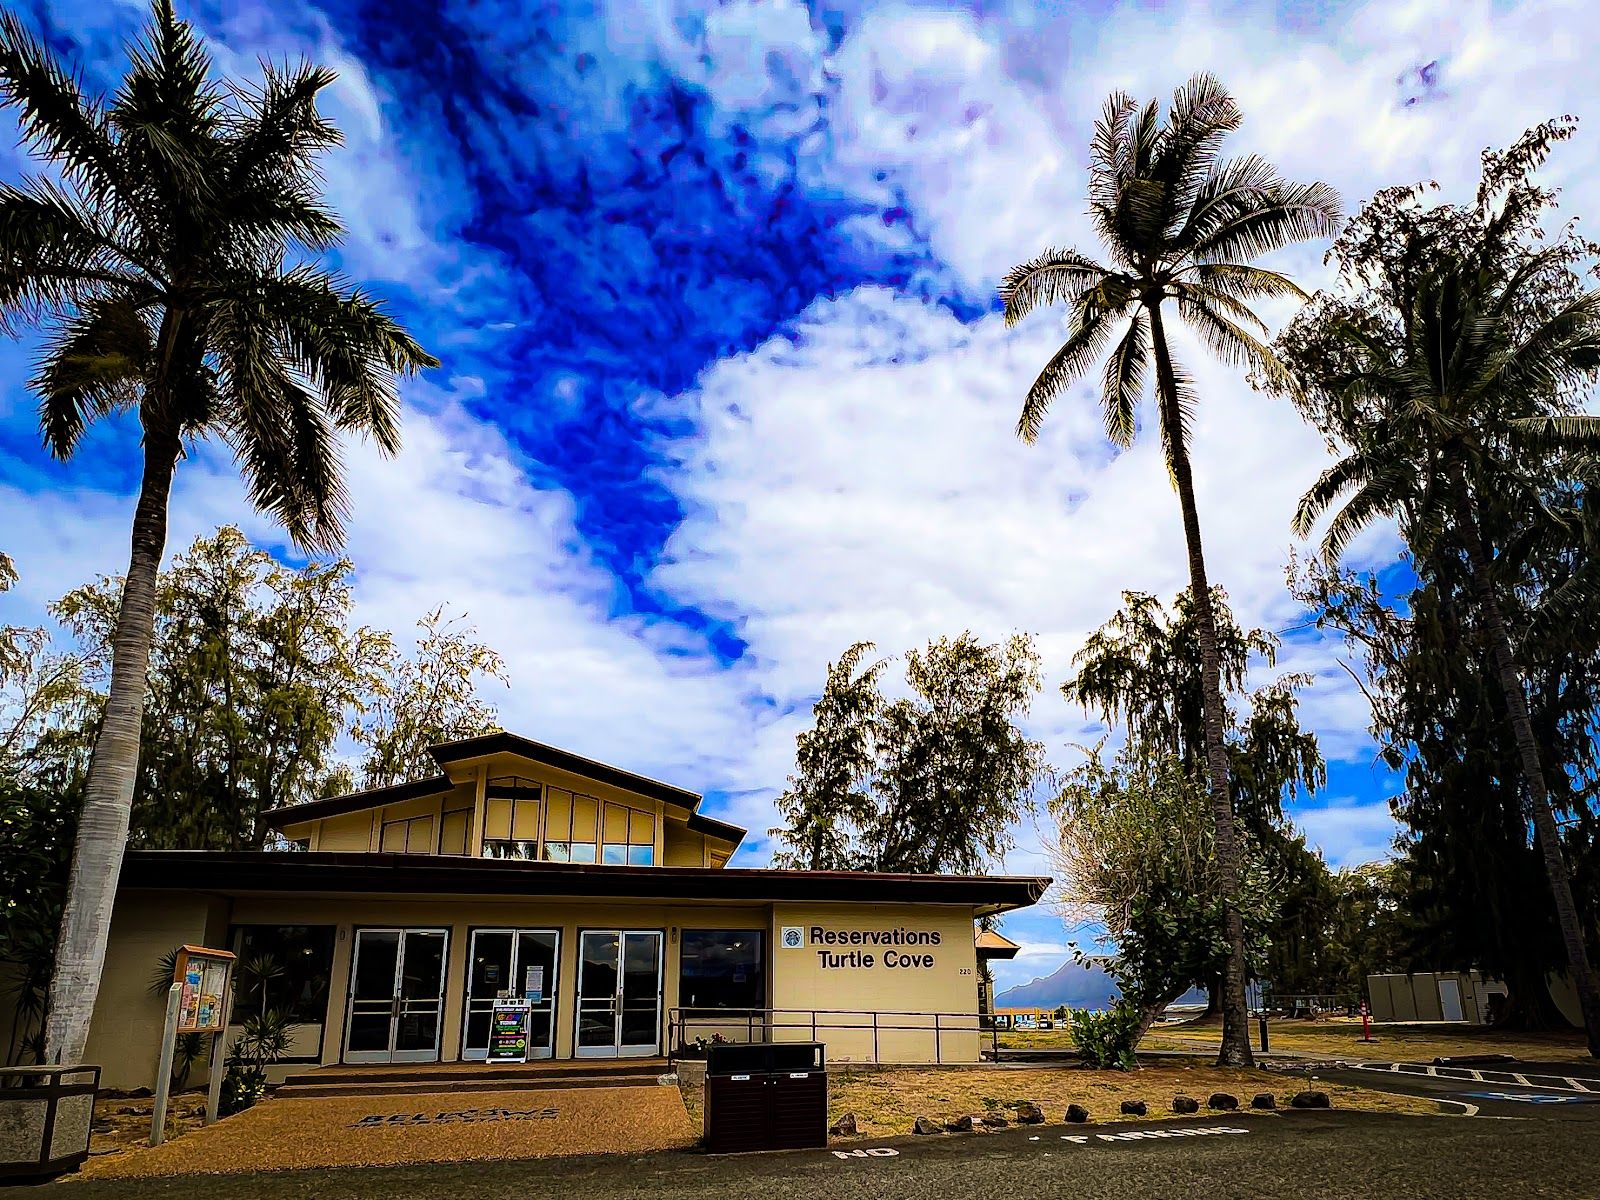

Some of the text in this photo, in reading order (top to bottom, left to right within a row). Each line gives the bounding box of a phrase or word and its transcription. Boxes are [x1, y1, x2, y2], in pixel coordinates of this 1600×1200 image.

[810, 926, 941, 945] Reservations
[817, 950, 934, 968] Turtle Cove
[831, 1147, 900, 1160] NO
